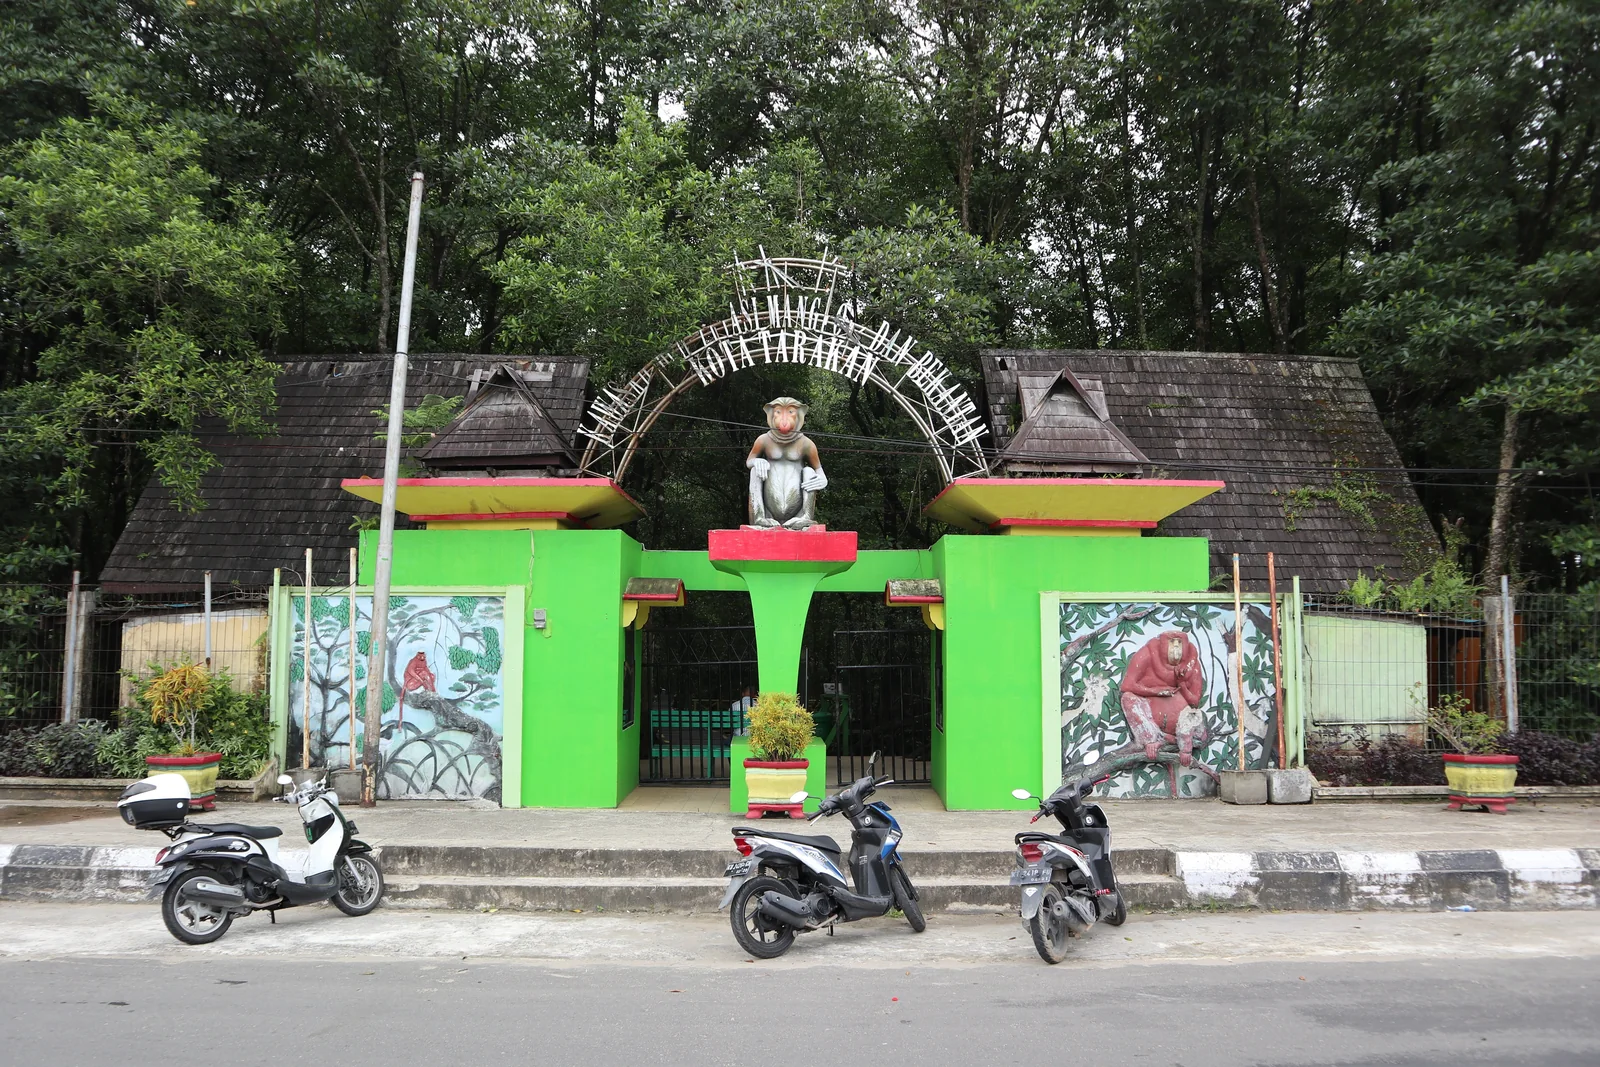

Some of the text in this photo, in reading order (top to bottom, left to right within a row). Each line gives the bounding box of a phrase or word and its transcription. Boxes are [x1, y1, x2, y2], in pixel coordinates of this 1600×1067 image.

[687, 335, 755, 387] KOTA
[757, 329, 881, 387] TARAKAN
[869, 320, 918, 366] DAN
[907, 350, 990, 448] BEKANTAN
